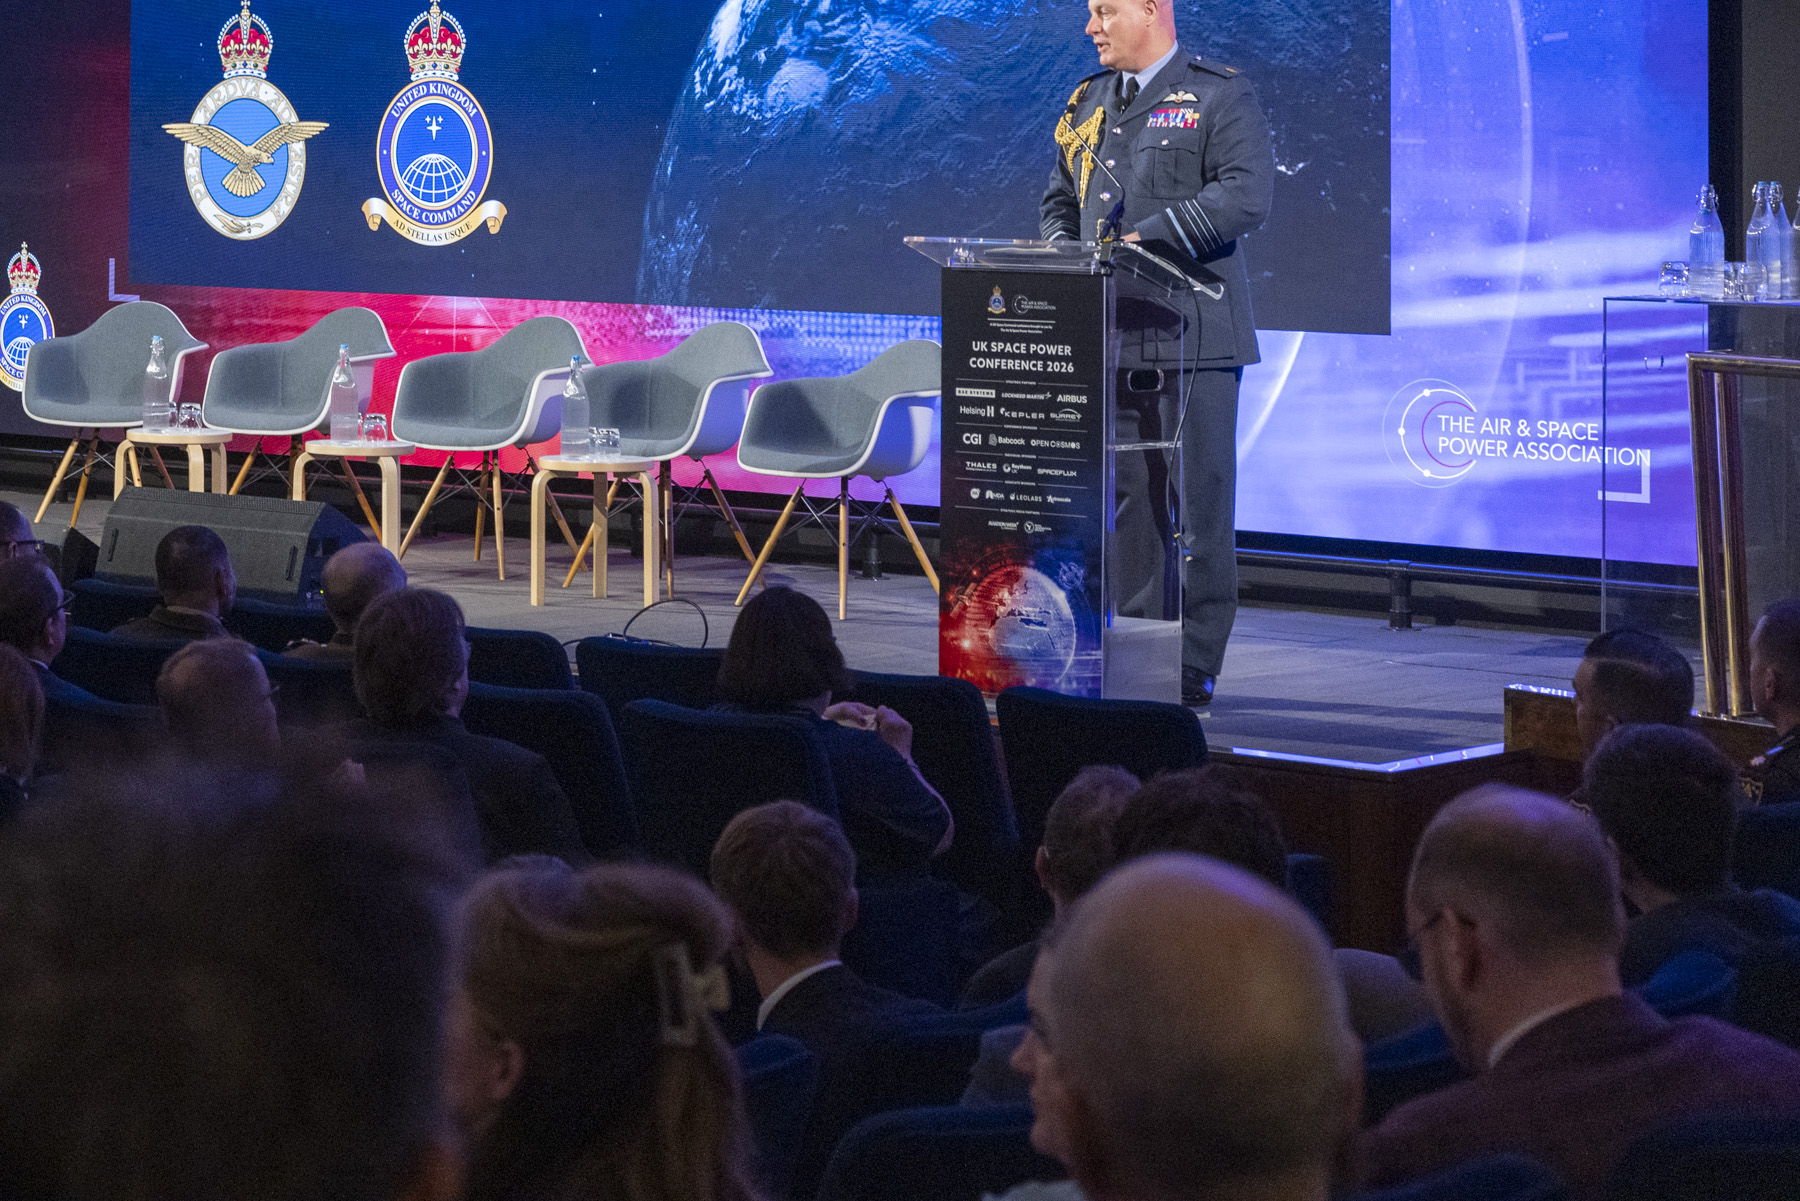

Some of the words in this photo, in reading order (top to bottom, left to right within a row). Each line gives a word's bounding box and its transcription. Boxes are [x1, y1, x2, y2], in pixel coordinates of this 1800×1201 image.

[391, 84, 427, 118] UNITED
[430, 82, 478, 118] KINGDOM
[392, 189, 419, 220] SPACE
[422, 190, 476, 222] COMMAND
[394, 220, 406, 231] AD
[406, 228, 442, 242] STELLAS
[444, 221, 472, 240] USQUE
[0, 296, 20, 315] UNITED
[21, 295, 47, 316] KINGDOM
[972, 341, 988, 352] UK
[991, 342, 1026, 354] SPACE
[1030, 344, 1072, 356] POWER
[0, 357, 16, 376] SPACE
[970, 358, 1044, 371] CONFERENCE
[1047, 362, 1074, 373] 2026
[1057, 394, 1087, 404] AIRBUS
[960, 406, 985, 416] Helsing
[1005, 411, 1044, 419] KEPLER
[1438, 415, 1474, 434] THE
[1480, 418, 1510, 436] AIR
[1516, 419, 1531, 437] &
[1536, 420, 1598, 441] SPACE
[963, 433, 982, 444] CGI
[998, 436, 1025, 446] Babcock
[1438, 437, 1508, 458] POWER
[1513, 442, 1650, 467] ASSOCIATION
